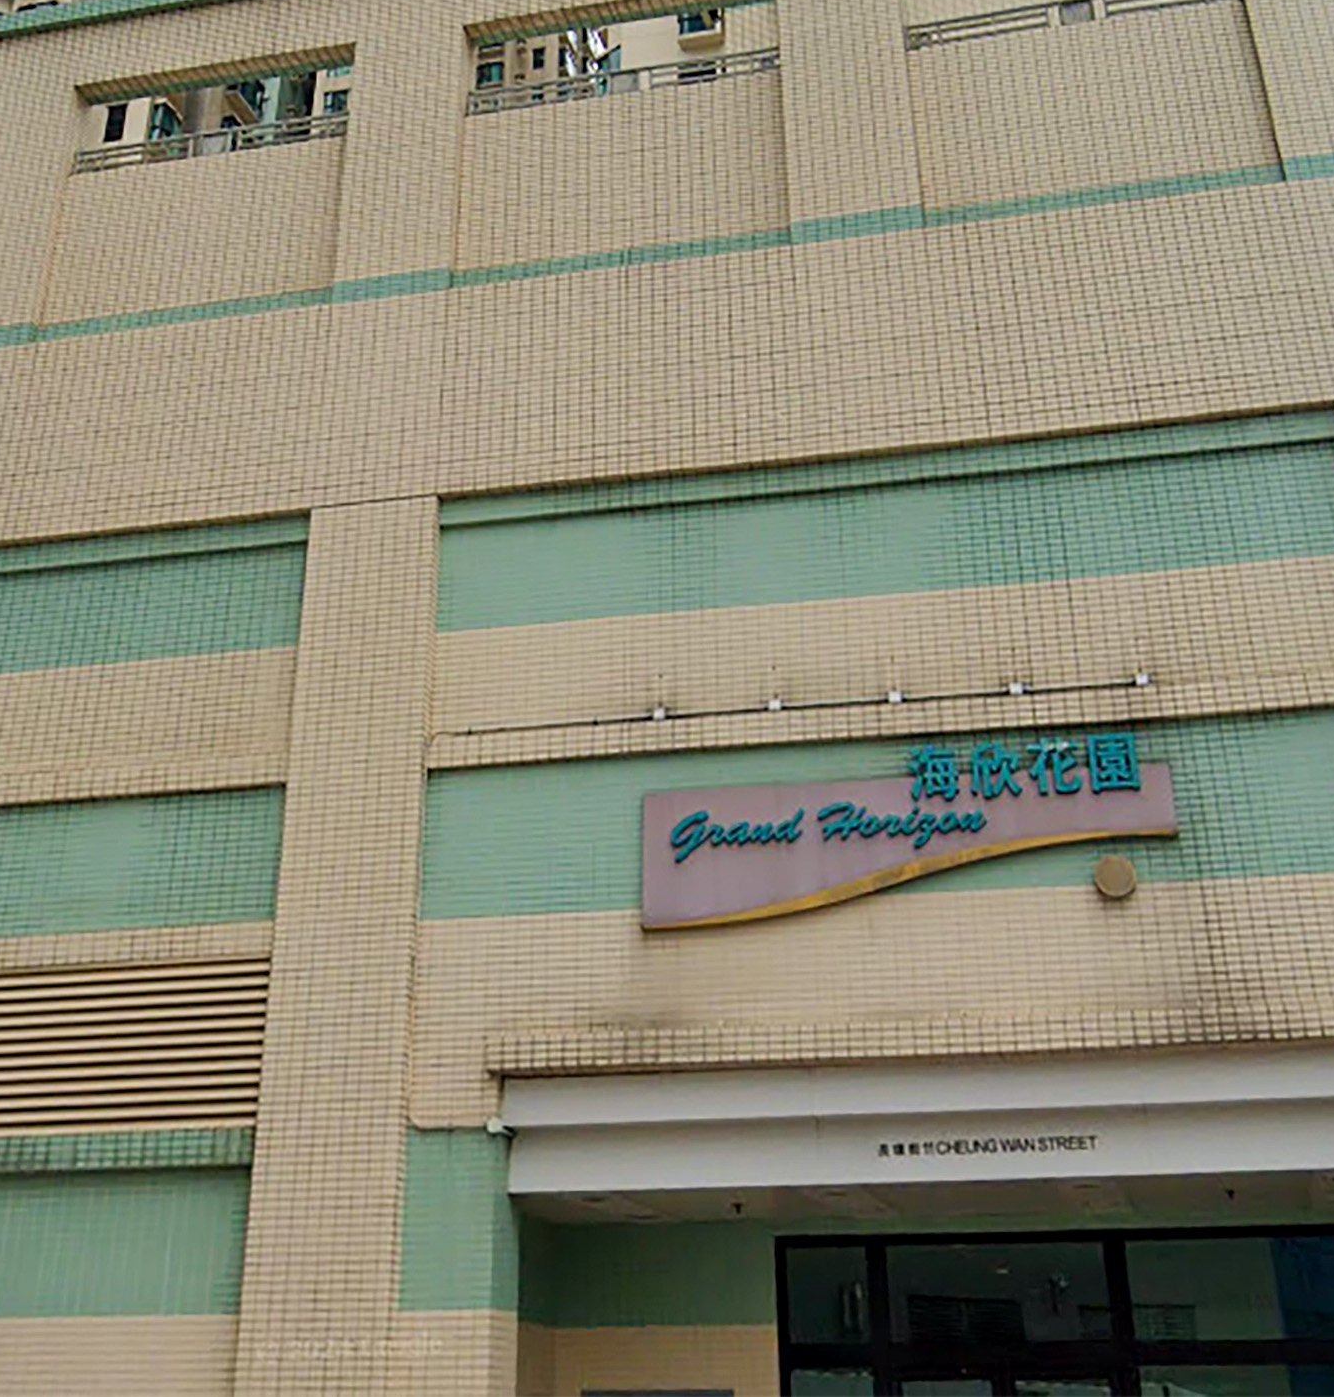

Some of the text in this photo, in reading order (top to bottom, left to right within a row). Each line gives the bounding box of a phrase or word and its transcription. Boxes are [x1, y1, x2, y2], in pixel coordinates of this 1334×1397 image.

[907, 733, 1142, 801] 海欣花園
[669, 801, 988, 863] Grand Horizon
[936, 1138, 997, 1155] CHEUNG
[1000, 1136, 1036, 1153] WAN
[1038, 1135, 1097, 1152] STREET
